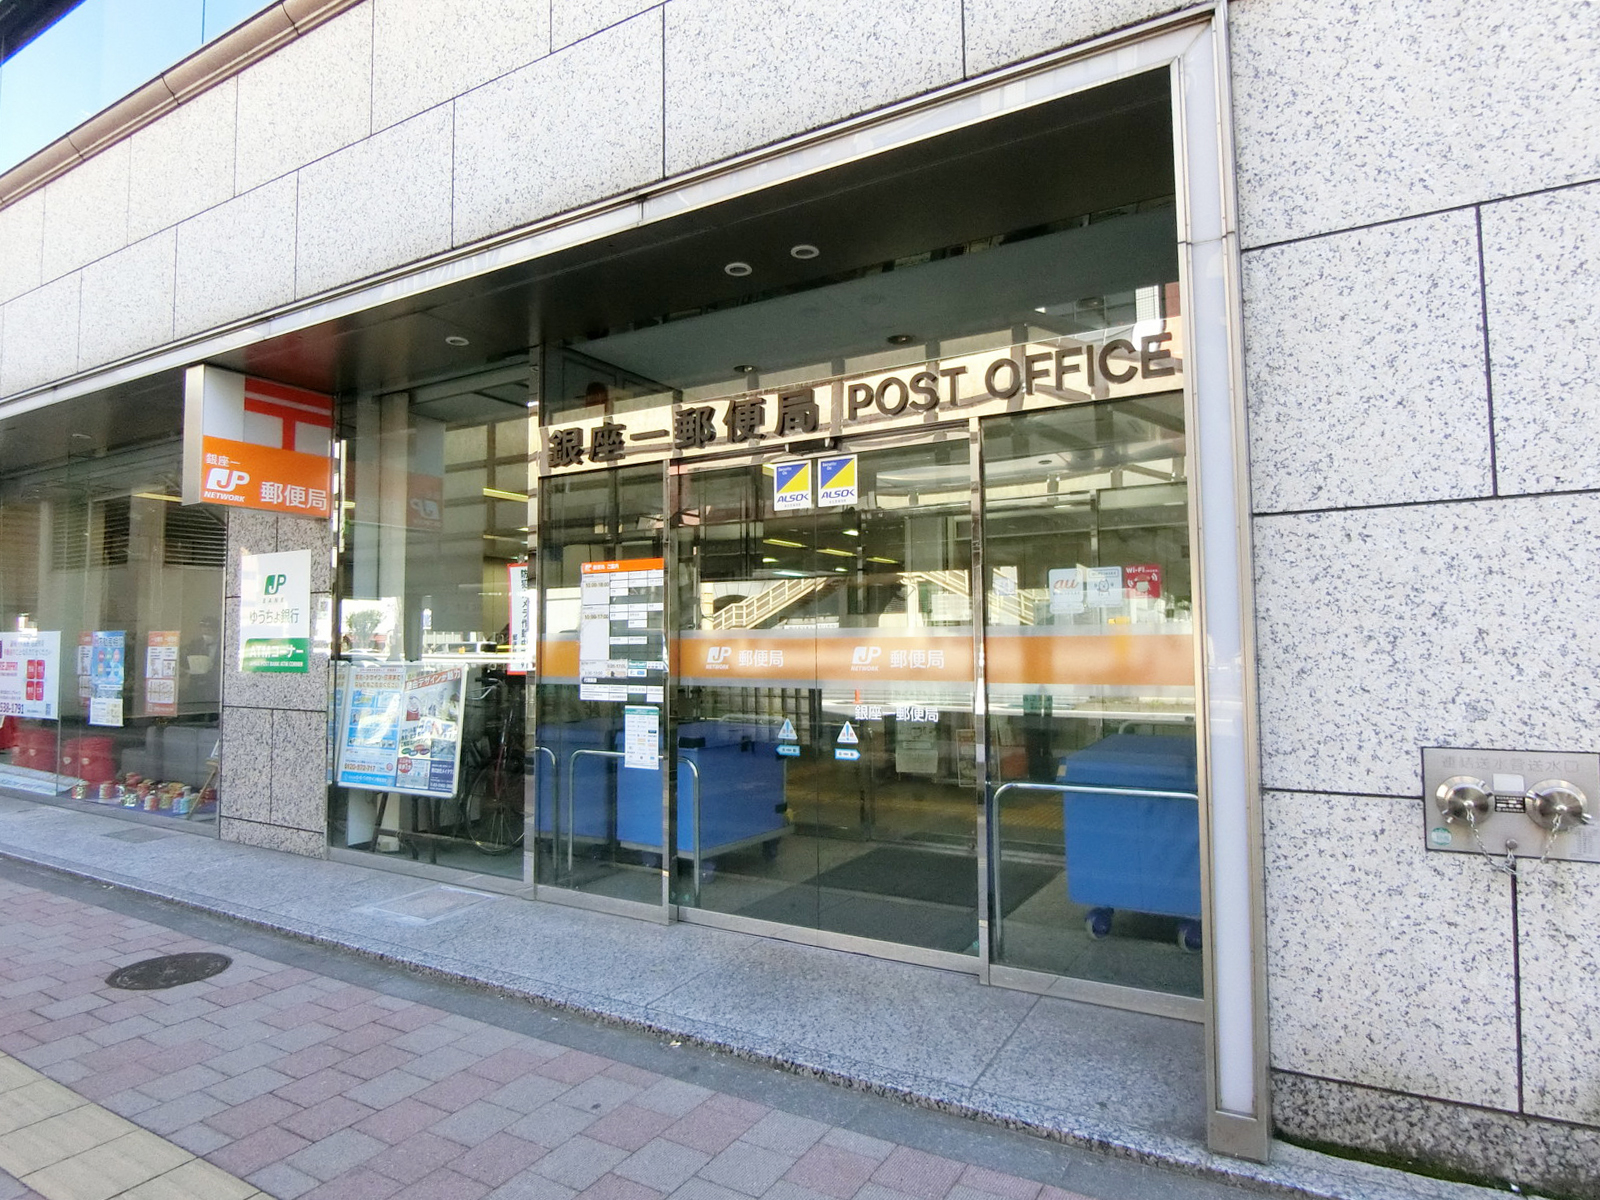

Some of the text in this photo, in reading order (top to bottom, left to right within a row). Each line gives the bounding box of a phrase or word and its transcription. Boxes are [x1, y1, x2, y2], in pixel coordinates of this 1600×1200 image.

[847, 332, 1175, 421] POST OFFICE
[549, 387, 819, 468] 銀座一郵便局
[205, 453, 240, 467] 銀座一
[206, 467, 250, 492] JP
[203, 490, 245, 502] NETWORK
[261, 481, 327, 511] 郵便局
[777, 493, 809, 503] ALSOK
[821, 488, 855, 499] ALSOK
[264, 574, 287, 595] JP
[1054, 578, 1079, 590] au
[249, 608, 300, 624] ゆうちょ銀行
[707, 646, 732, 663] JP
[738, 650, 784, 667] 郵便局
[853, 646, 882, 665] JP
[890, 649, 945, 669] 郵便局
[854, 705, 939, 723] 銀座一郵便局
